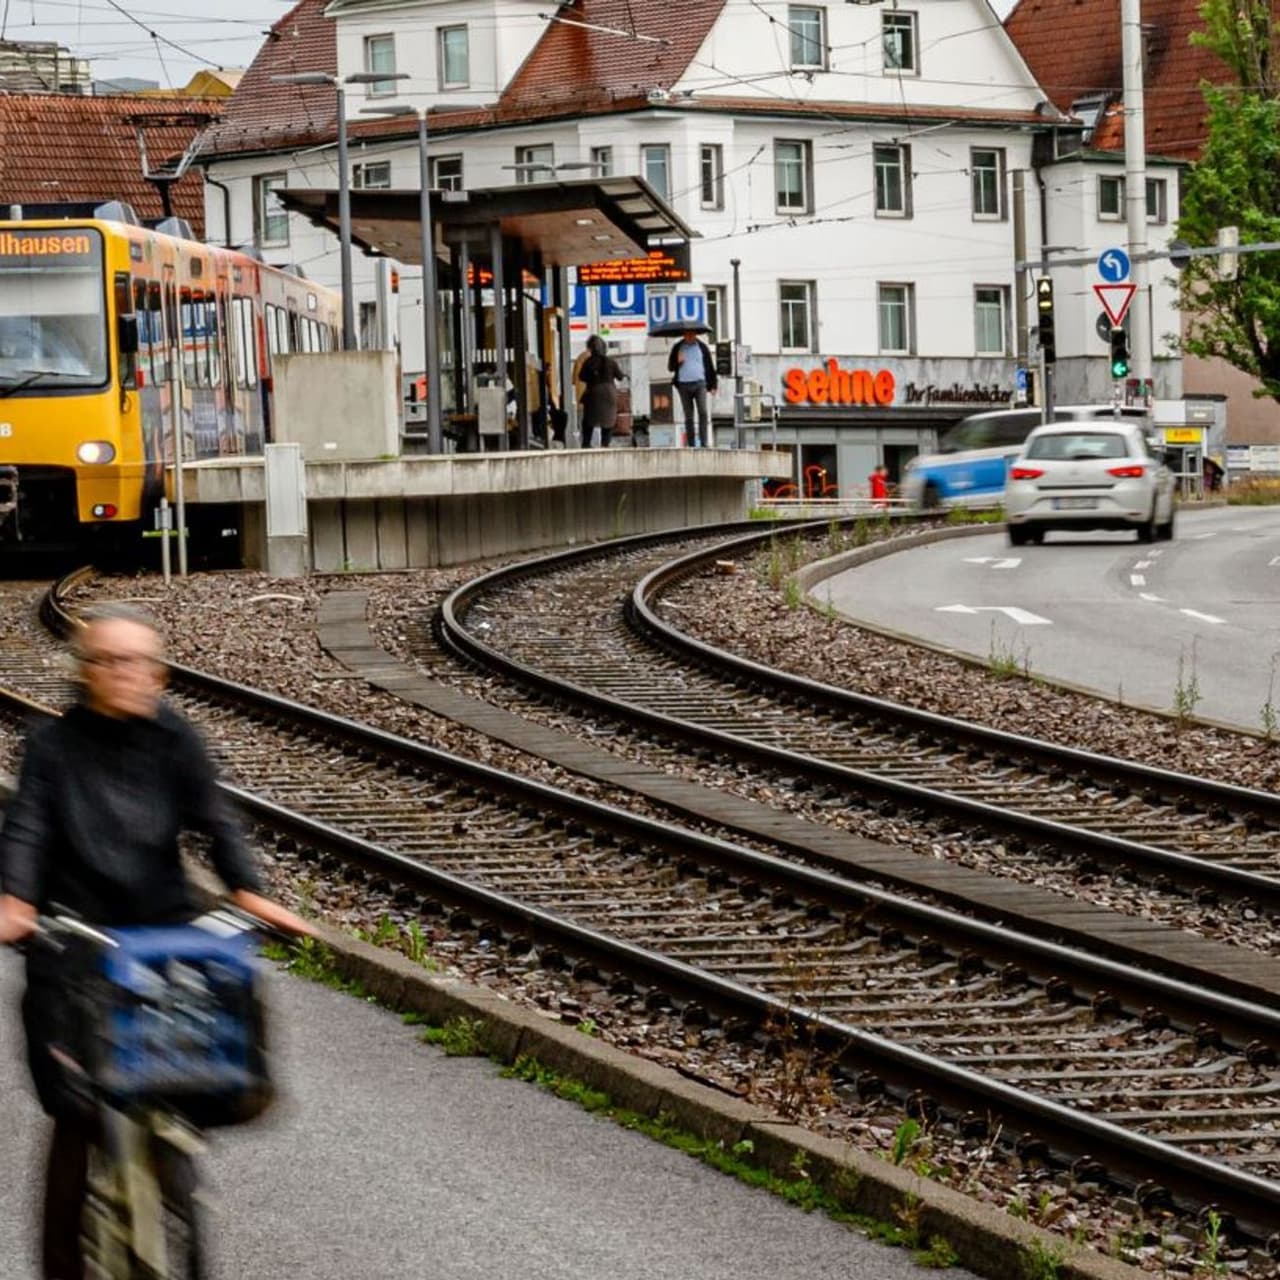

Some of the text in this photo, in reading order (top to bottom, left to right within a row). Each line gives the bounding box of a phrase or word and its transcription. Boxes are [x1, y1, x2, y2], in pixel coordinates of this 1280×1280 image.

[610, 283, 635, 309] U
[651, 296, 666, 322] U
[680, 296, 700, 321] U
[784, 356, 896, 405] sehne
